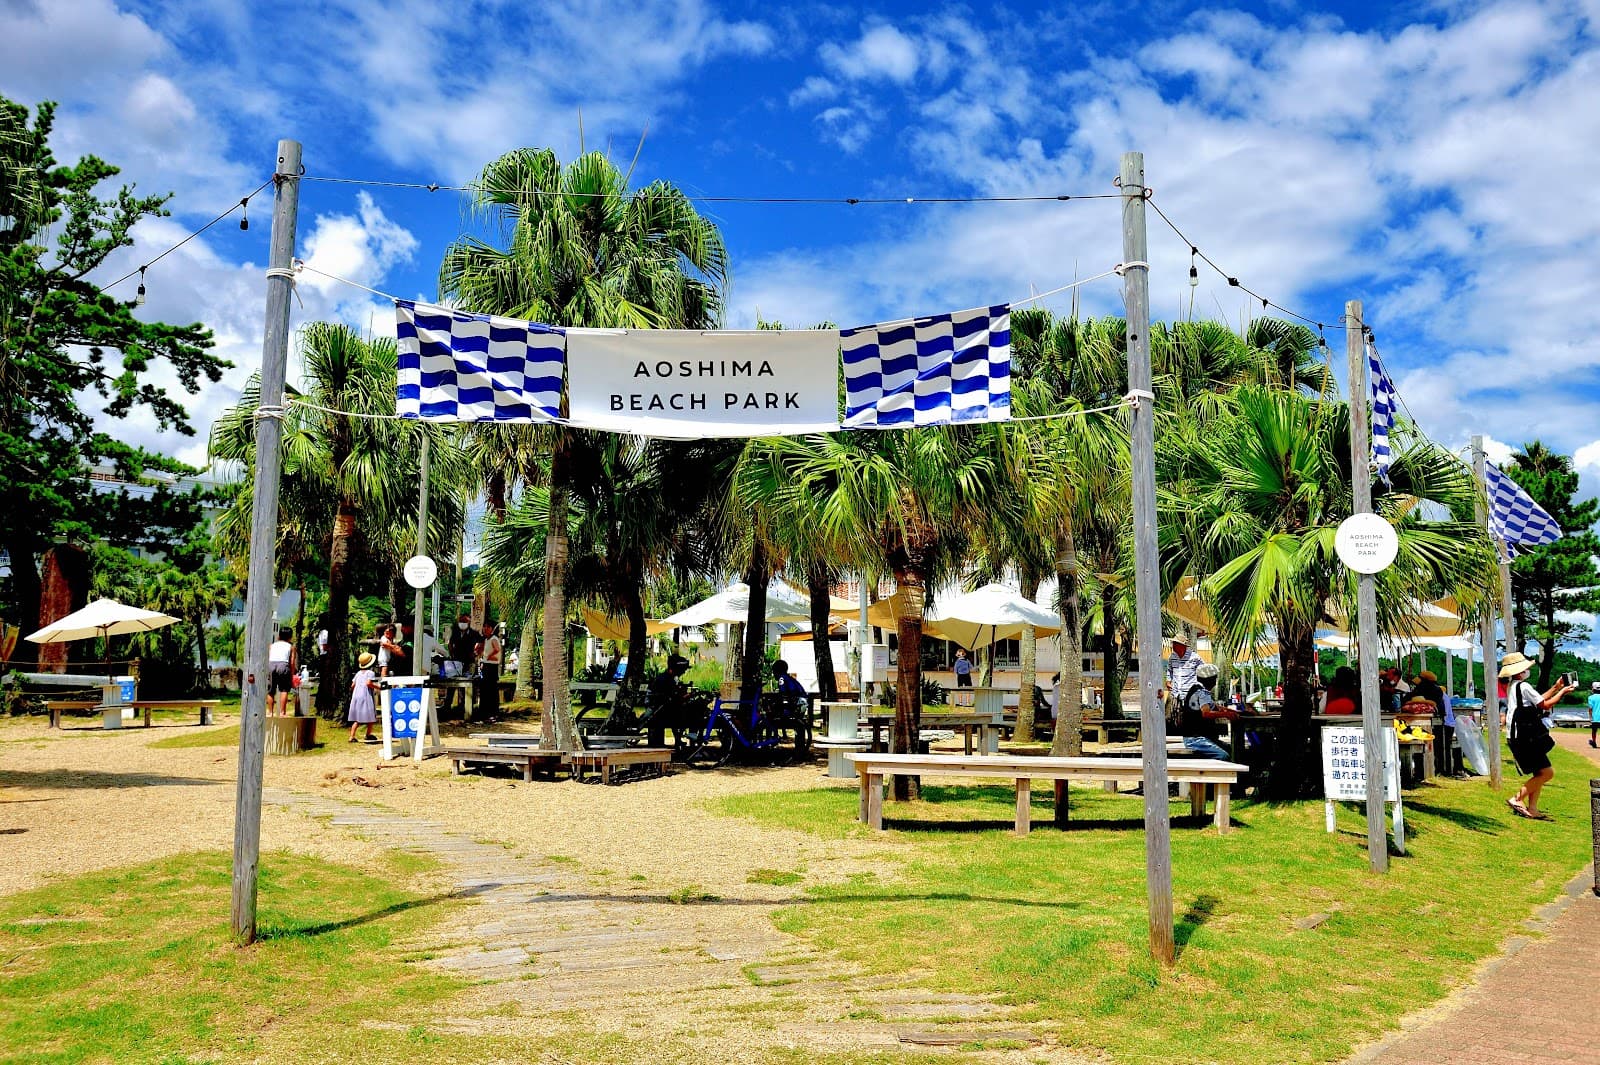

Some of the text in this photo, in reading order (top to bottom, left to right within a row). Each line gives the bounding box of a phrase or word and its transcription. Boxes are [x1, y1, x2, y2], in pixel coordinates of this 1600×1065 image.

[633, 360, 774, 378] AOSHIMA
[610, 392, 800, 411] BEACH PARK
[1331, 747, 1358, 757] 歩行者
